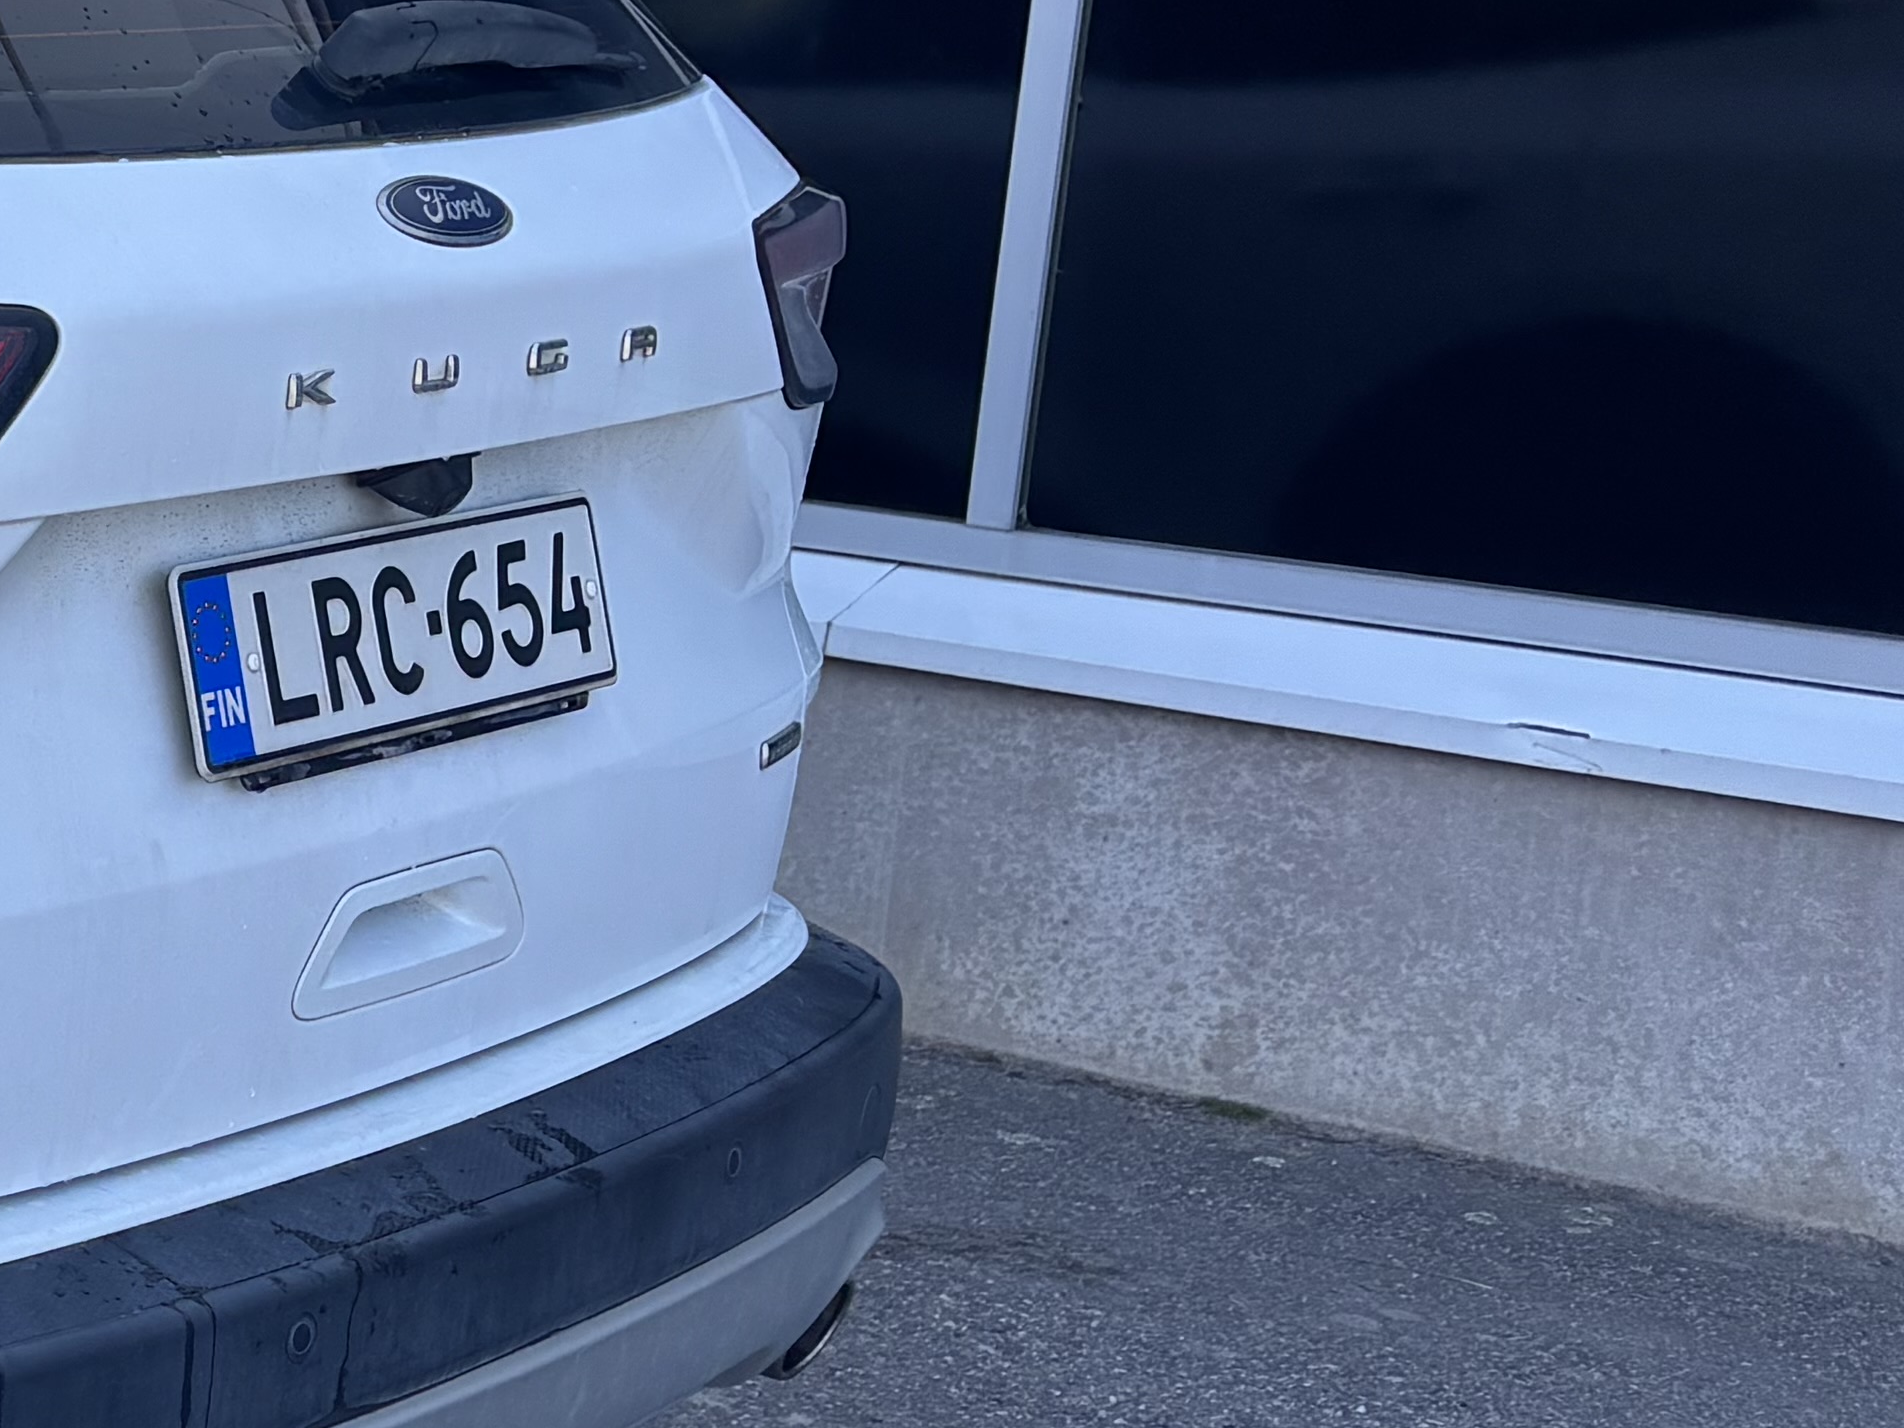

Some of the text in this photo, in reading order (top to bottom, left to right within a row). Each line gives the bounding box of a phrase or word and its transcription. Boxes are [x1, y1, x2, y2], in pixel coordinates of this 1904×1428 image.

[415, 185, 491, 223] Ford
[285, 325, 658, 410] KUGA
[253, 531, 592, 726] LRC-654
[201, 685, 246, 732] FIN
